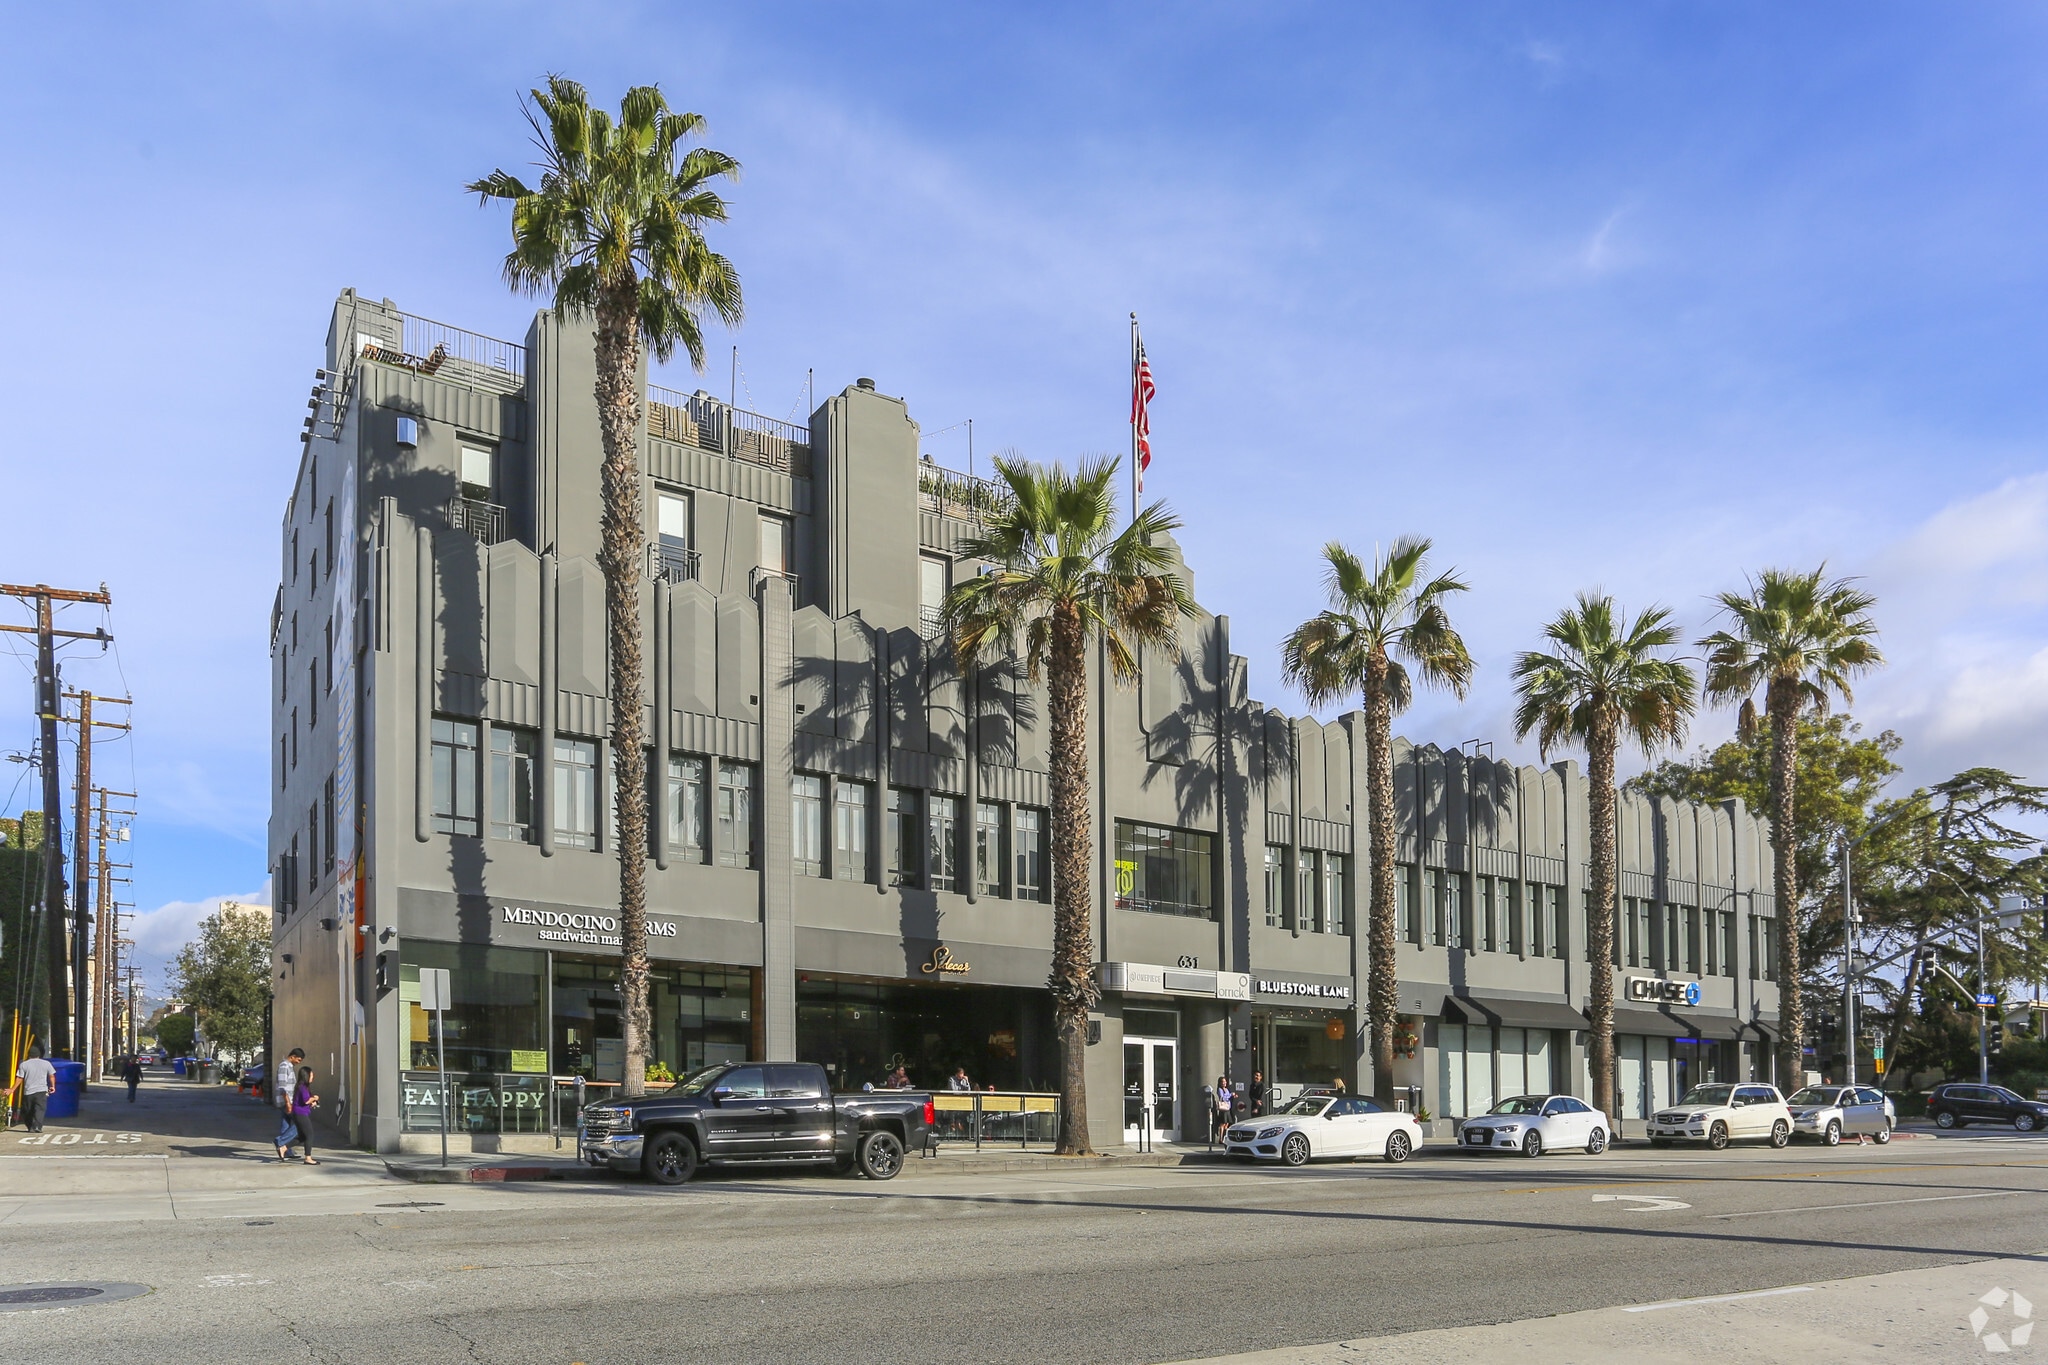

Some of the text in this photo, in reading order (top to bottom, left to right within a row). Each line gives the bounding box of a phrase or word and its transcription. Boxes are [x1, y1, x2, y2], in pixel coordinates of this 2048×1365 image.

[503, 906, 616, 931] MENDOCINO
[539, 928, 598, 944] sandwich
[1177, 955, 1198, 969] 631
[1218, 986, 1245, 998] orrick
[1259, 980, 1350, 998] BLUESTONE LANE
[1632, 980, 1685, 1002] CHASE
[854, 1011, 860, 1020] D
[404, 1088, 545, 1108] EAT HAPPY
[18, 1133, 142, 1145] STOP
